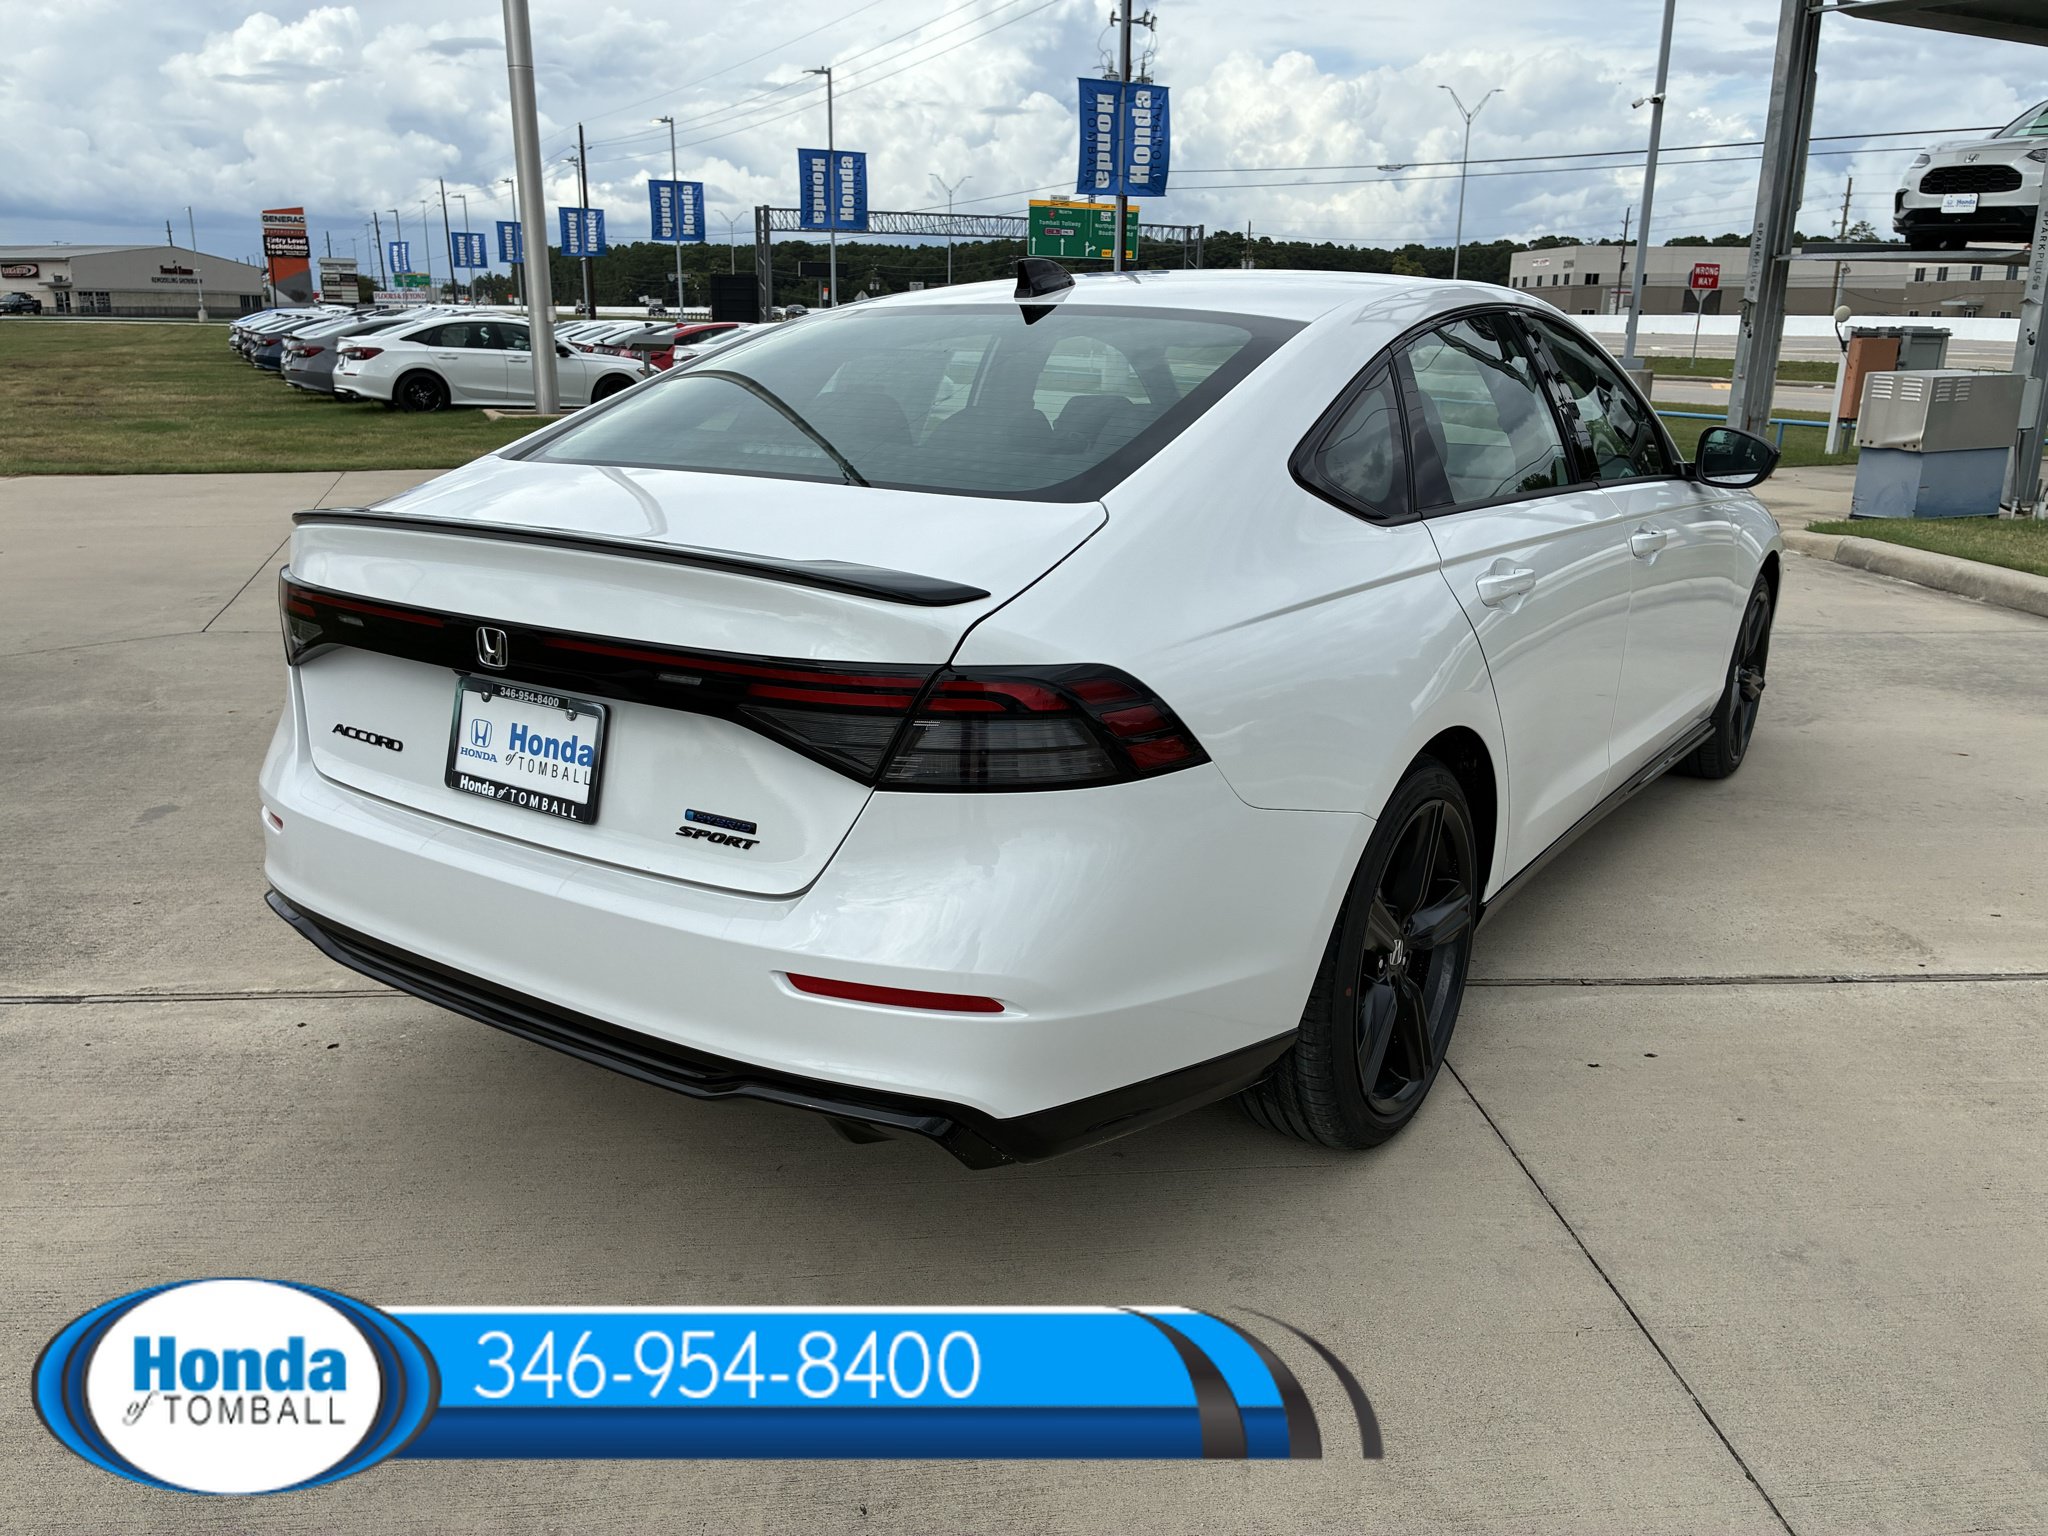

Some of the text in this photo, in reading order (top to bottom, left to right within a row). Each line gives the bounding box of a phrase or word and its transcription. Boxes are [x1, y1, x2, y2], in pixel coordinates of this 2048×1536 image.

[1095, 94, 1114, 188] Honda
[1129, 91, 1151, 183] Honda
[812, 158, 826, 223] Honda
[839, 156, 854, 220] Honda
[262, 215, 304, 223] GENERAC
[660, 187, 673, 237] Honda
[682, 185, 695, 234] Honda
[1062, 220, 1081, 228] Tollway
[505, 226, 514, 261] Honda
[568, 213, 579, 253] Honda
[586, 211, 598, 251] Honda
[1695, 267, 1719, 275] WRONG
[1697, 277, 1713, 285] WAY
[332, 723, 404, 752] ACCORD
[460, 747, 498, 763] HONDA
[509, 723, 594, 767] Honda
[505, 752, 590, 786] of TOMBALL
[460, 775, 577, 819] Honda of TOMBALL
[675, 826, 760, 850] SPORT
